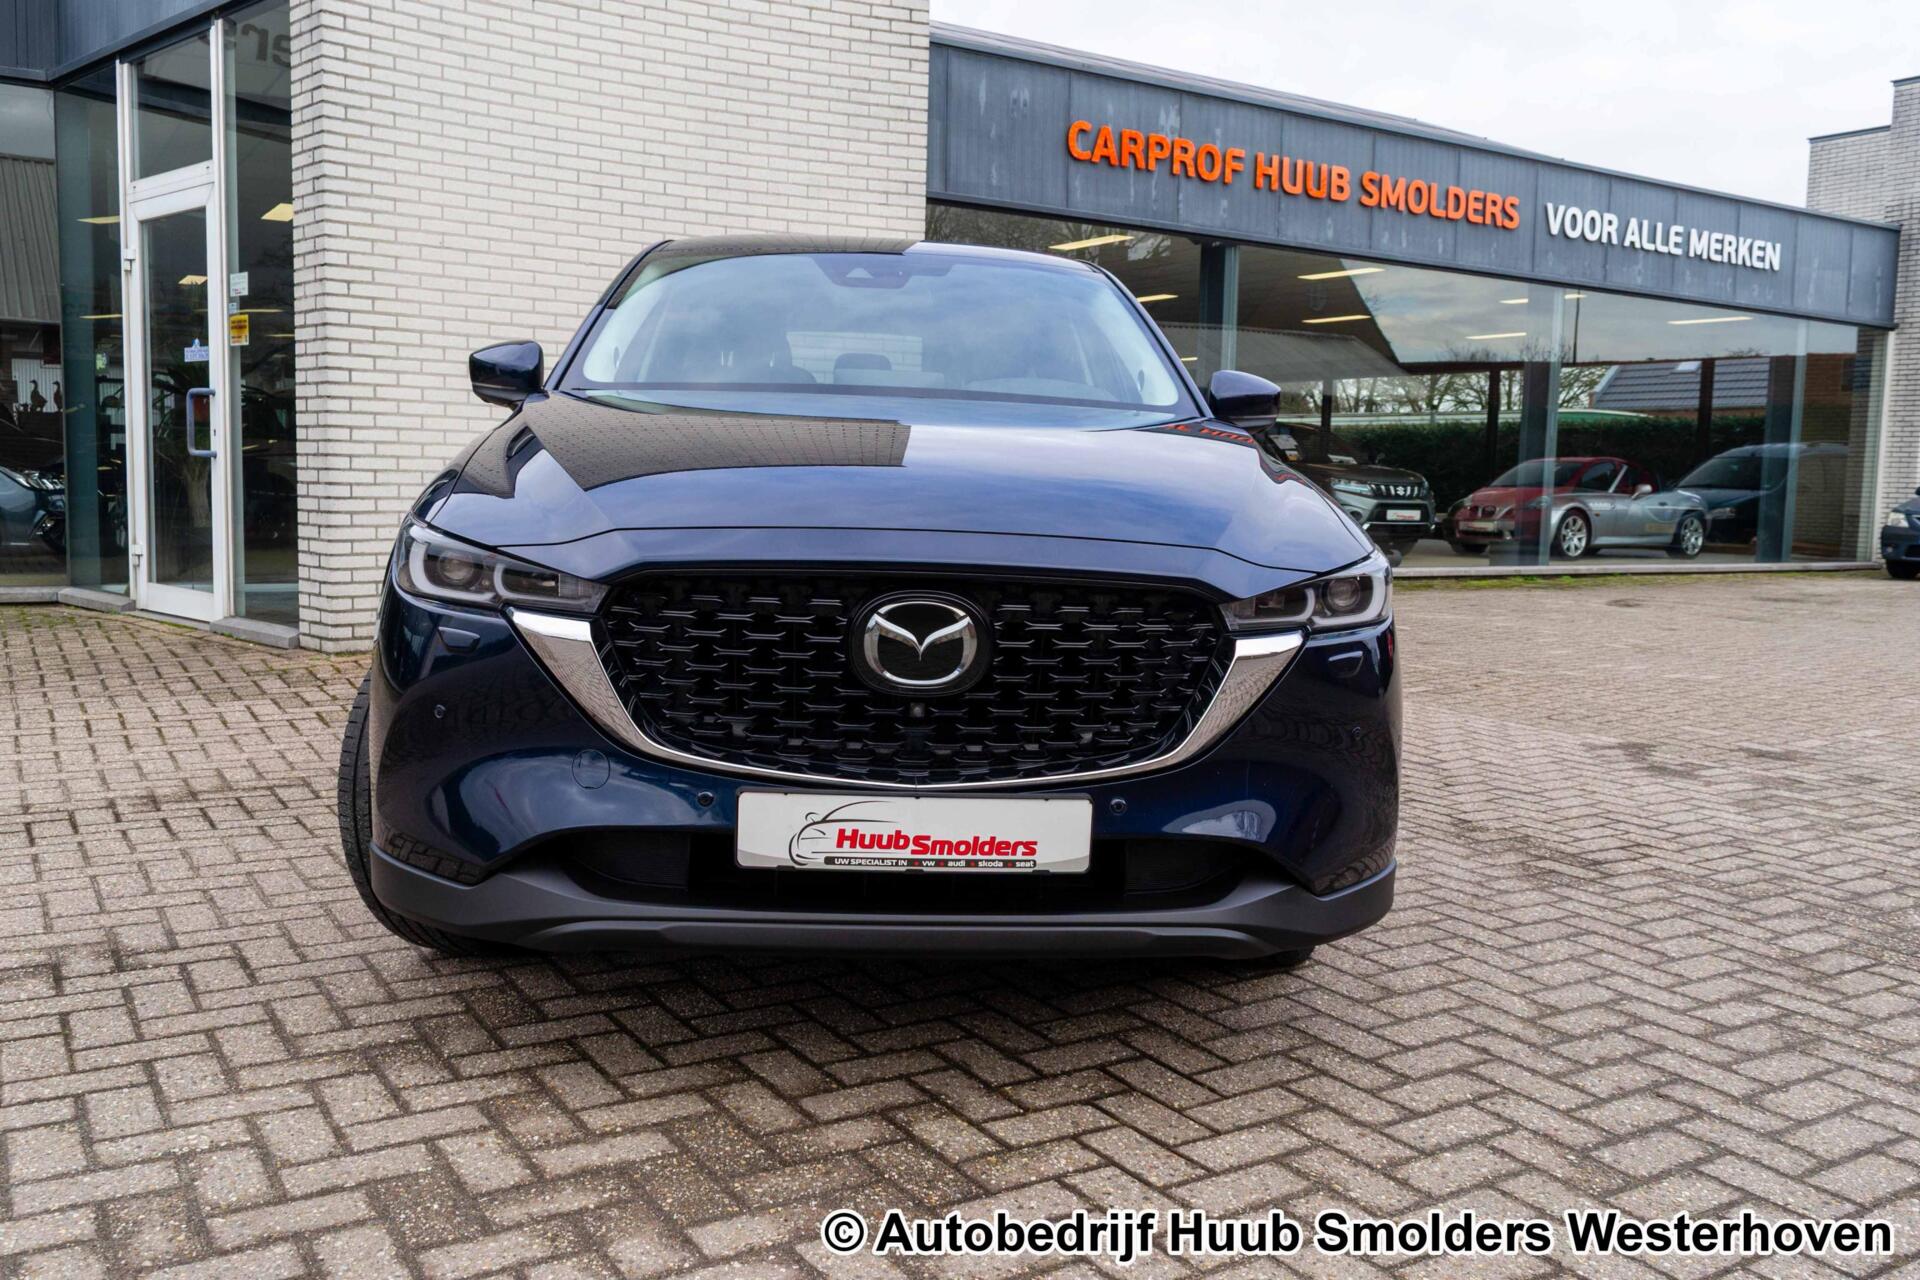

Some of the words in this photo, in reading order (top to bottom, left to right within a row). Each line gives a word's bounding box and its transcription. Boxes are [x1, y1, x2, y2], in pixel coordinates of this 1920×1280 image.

[1067, 119, 1246, 185] CARPROF
[1254, 151, 1352, 202] HUUB
[1359, 171, 1521, 230] SMOLDERS
[1545, 202, 1618, 245] VOOR
[1623, 217, 1684, 255] ALLE
[1688, 228, 1782, 271] MERKEN
[850, 858, 897, 866] SPECIALIST
[978, 860, 1004, 868] skoda
